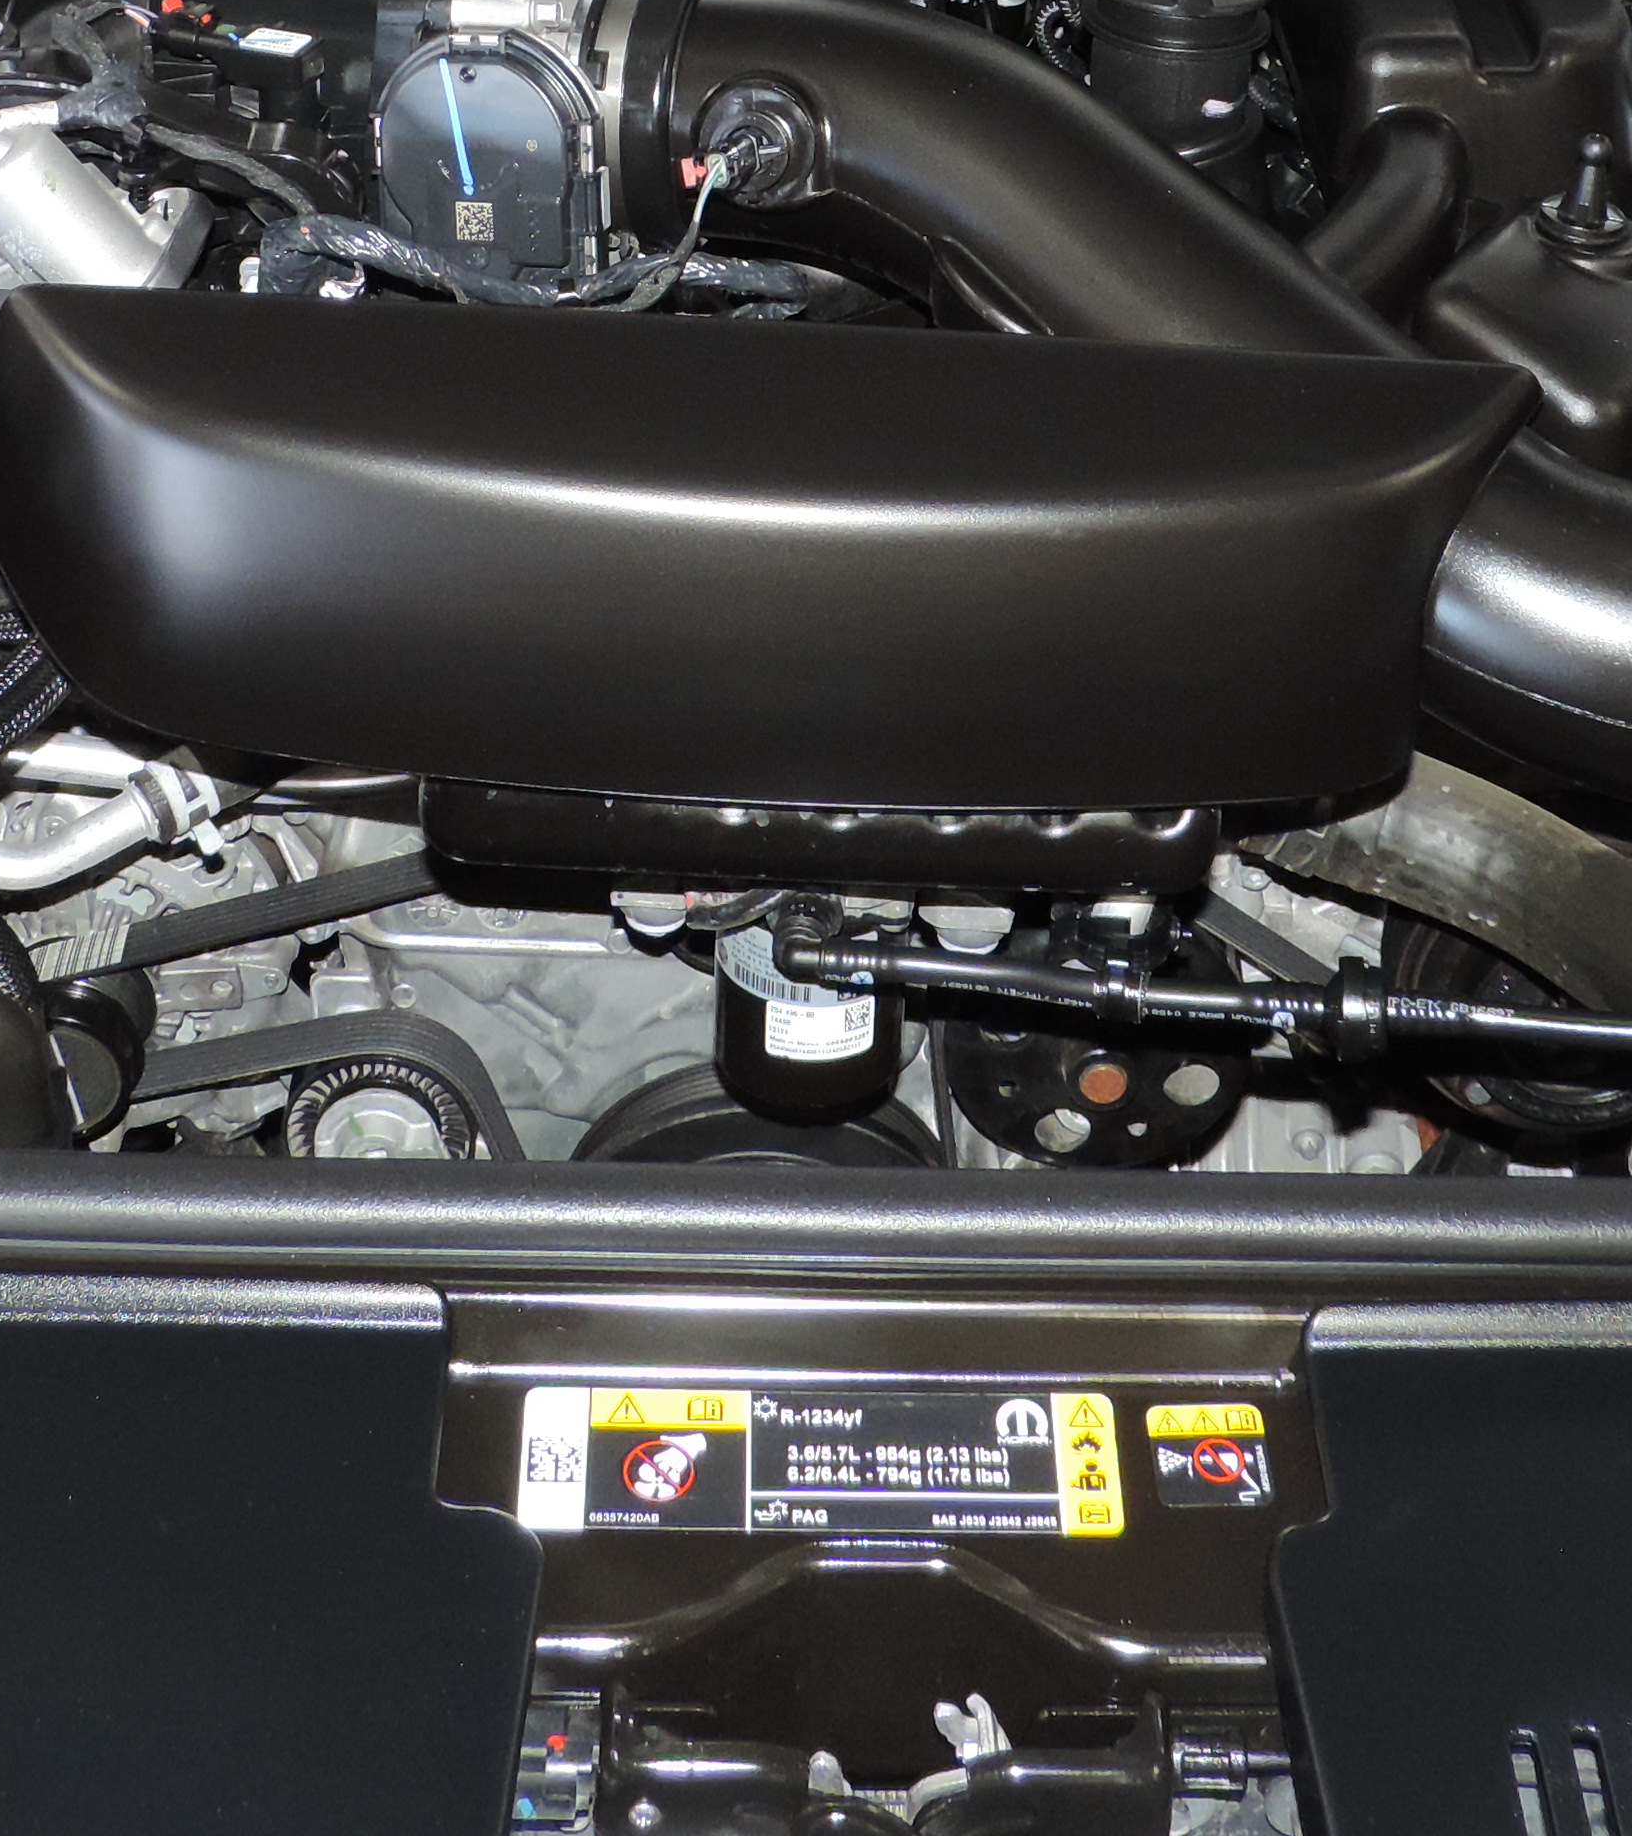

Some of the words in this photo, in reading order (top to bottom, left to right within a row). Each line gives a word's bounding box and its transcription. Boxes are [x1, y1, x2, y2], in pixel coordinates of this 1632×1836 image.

[780, 1407, 863, 1431] R-1234yf
[786, 1445, 861, 1464] 3.6/5.7L
[974, 1446, 1009, 1466] lbs)
[786, 1466, 861, 1484] 6.2/6.4L
[975, 1467, 1011, 1487] lbs)
[791, 1509, 828, 1525] PAG
